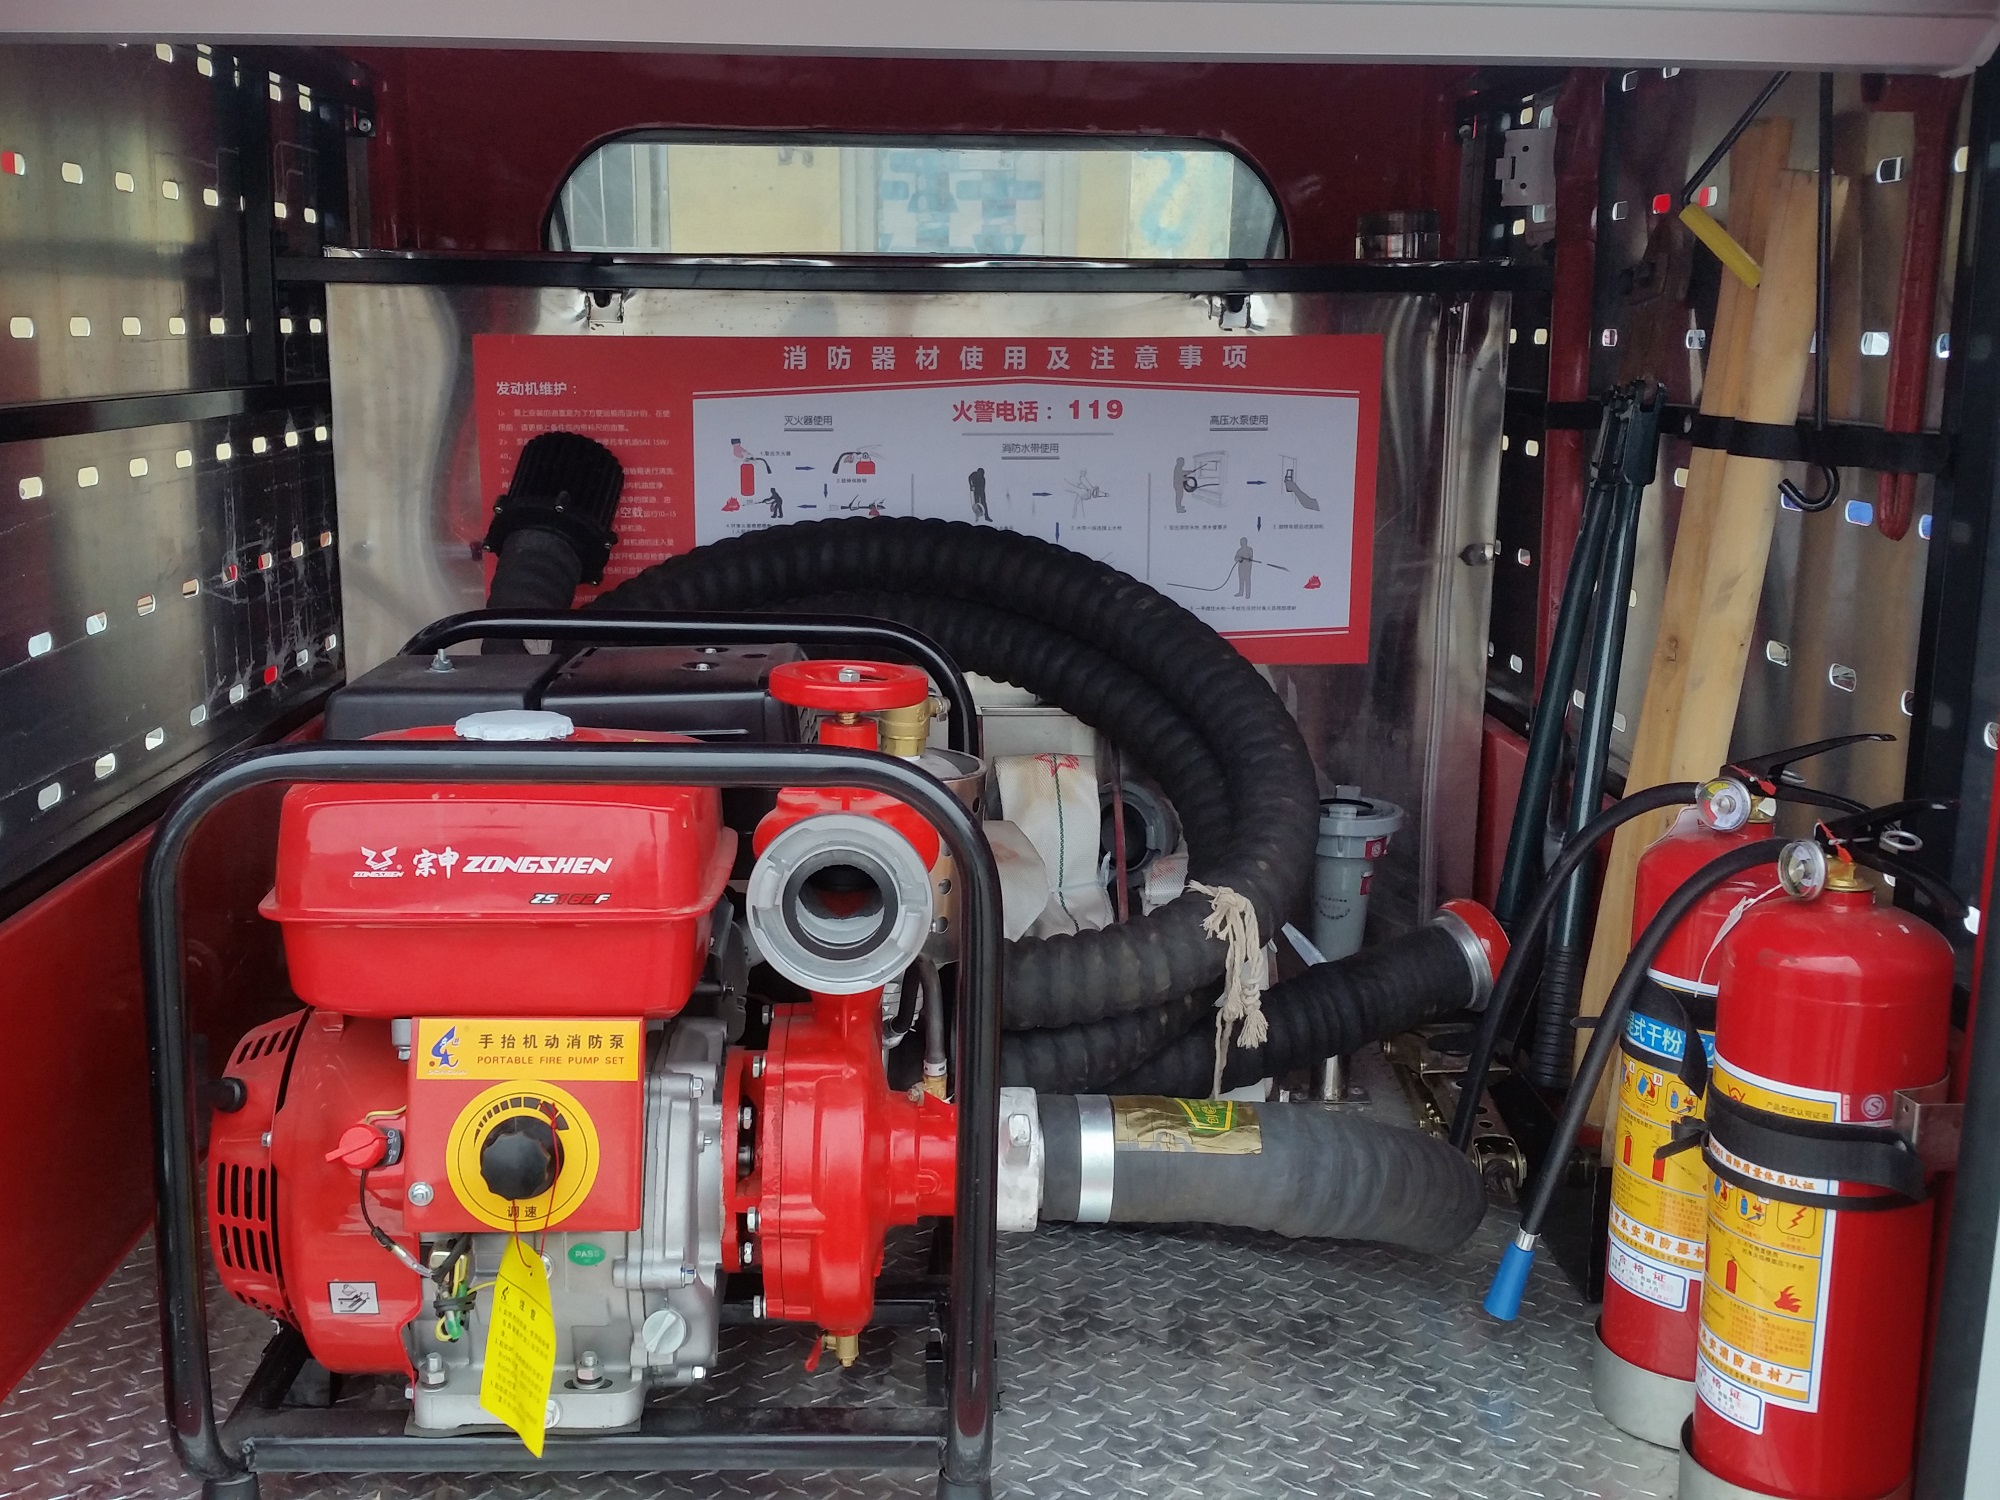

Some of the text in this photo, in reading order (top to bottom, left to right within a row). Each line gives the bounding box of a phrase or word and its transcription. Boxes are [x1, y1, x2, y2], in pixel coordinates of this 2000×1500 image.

[783, 344, 1247, 371] 消防器材使用及注意事项
[496, 381, 577, 396] 发动机维护：
[784, 415, 834, 426] 灭火器使用
[1209, 415, 1269, 426] 高压水泵使用
[1001, 443, 1060, 454] 消防水带使用
[412, 846, 614, 879] 宗申 ZONGSHEN
[478, 1034, 625, 1050] 手抬机动消防泵
[477, 1056, 625, 1065] PORTABLE FIRE PUMP SET
[1726, 1155, 1816, 1191] 国际质量体系认证
[507, 1205, 537, 1219] 调速
